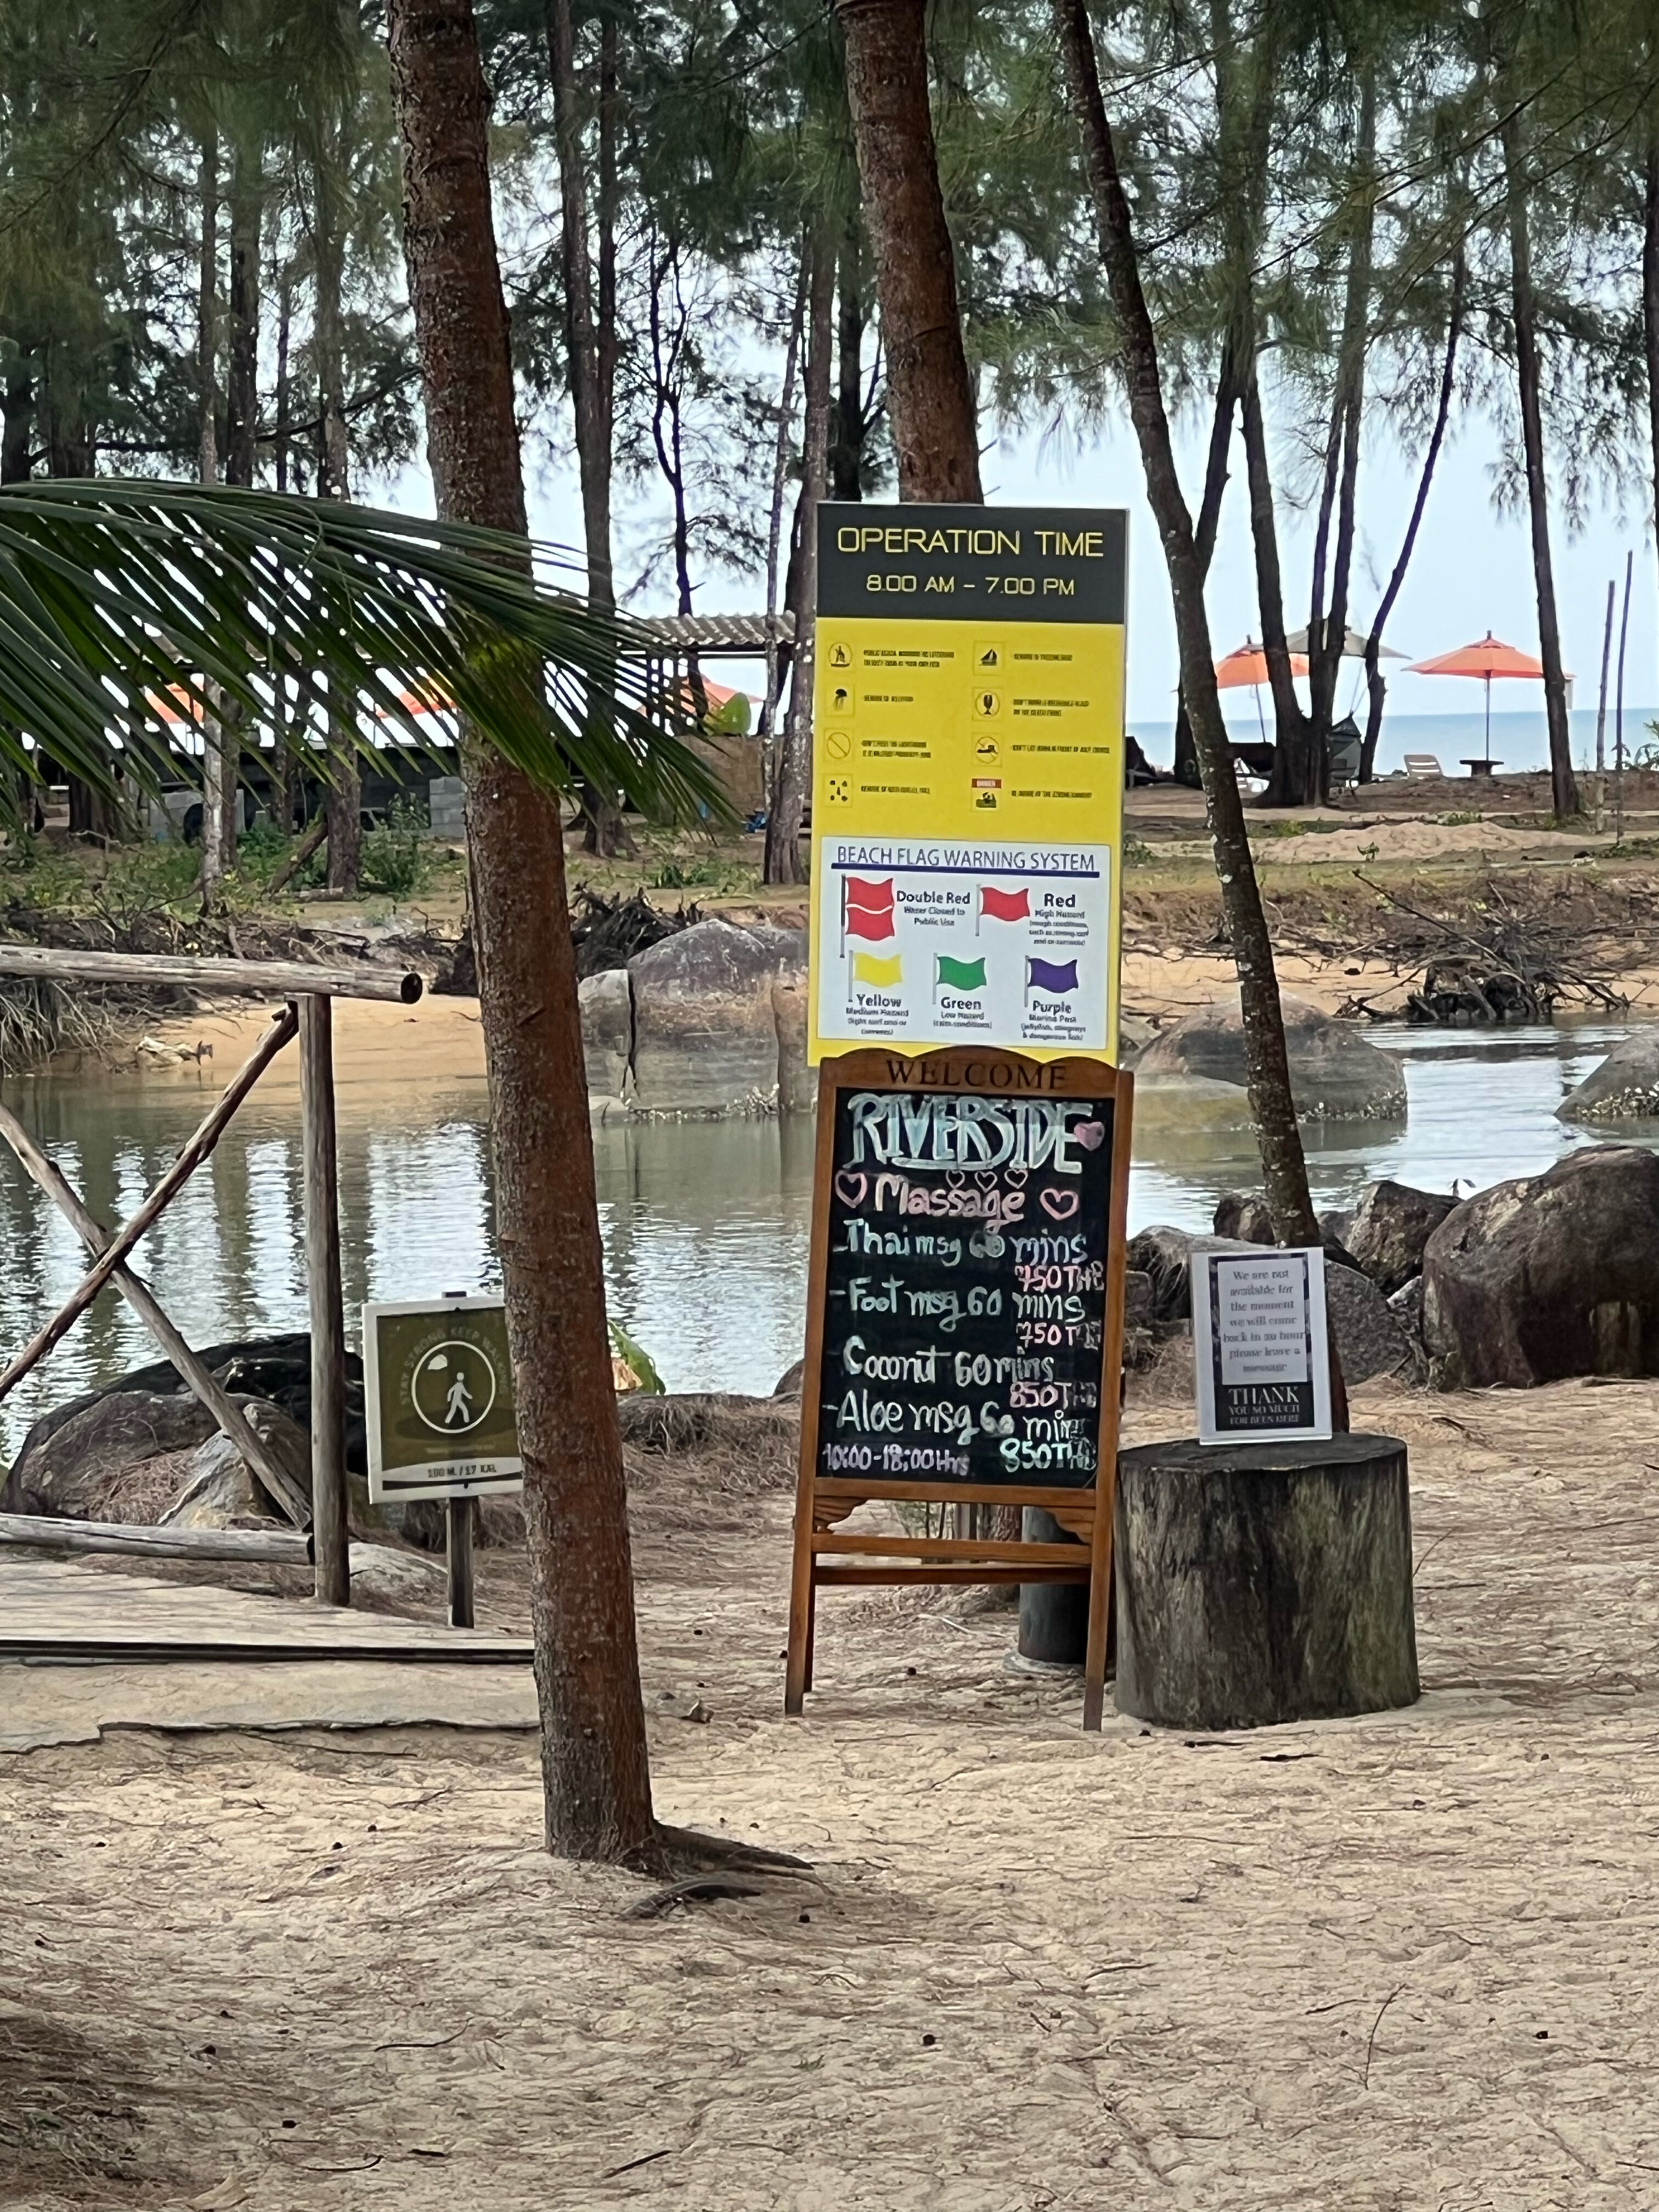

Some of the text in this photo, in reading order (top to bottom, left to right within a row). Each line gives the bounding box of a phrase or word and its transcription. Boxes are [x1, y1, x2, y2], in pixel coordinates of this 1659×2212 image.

[838, 527, 1104, 557] OPERATION TIME
[867, 574, 917, 592] 8.00
[924, 576, 955, 593] AM
[985, 577, 1035, 595] 7.00
[1043, 578, 1074, 596] PM
[838, 846, 1094, 871] BEACH FLAG WARNING SYSTEM
[897, 890, 970, 904] Double Red
[1044, 893, 1075, 907] Red
[856, 994, 901, 1007] Yellow
[941, 997, 981, 1009] Green
[1033, 1000, 1071, 1015] Purple
[887, 1059, 1066, 1090] WELCOME
[843, 1092, 1094, 1174] RIVERSIDE
[875, 1172, 1025, 1235] Massage
[915, 1236, 962, 1267] msg
[1009, 1228, 1088, 1266] mins
[1233, 1270, 1289, 1280] We are not
[1279, 1284, 1293, 1294] for
[904, 1290, 967, 1333] msg
[967, 1286, 1003, 1316] 60
[1012, 1291, 1086, 1323] mins
[1231, 1302, 1247, 1311] the
[1247, 1316, 1266, 1326] will
[1223, 1331, 1247, 1342] back
[954, 1351, 991, 1387] 60
[994, 1346, 1054, 1383] mins
[1228, 1386, 1300, 1405] THANK
[1229, 1406, 1250, 1415] YOU
[1268, 1404, 1300, 1413] MUCH
[908, 1400, 980, 1445] msg
[1230, 1416, 1248, 1424] FOR
